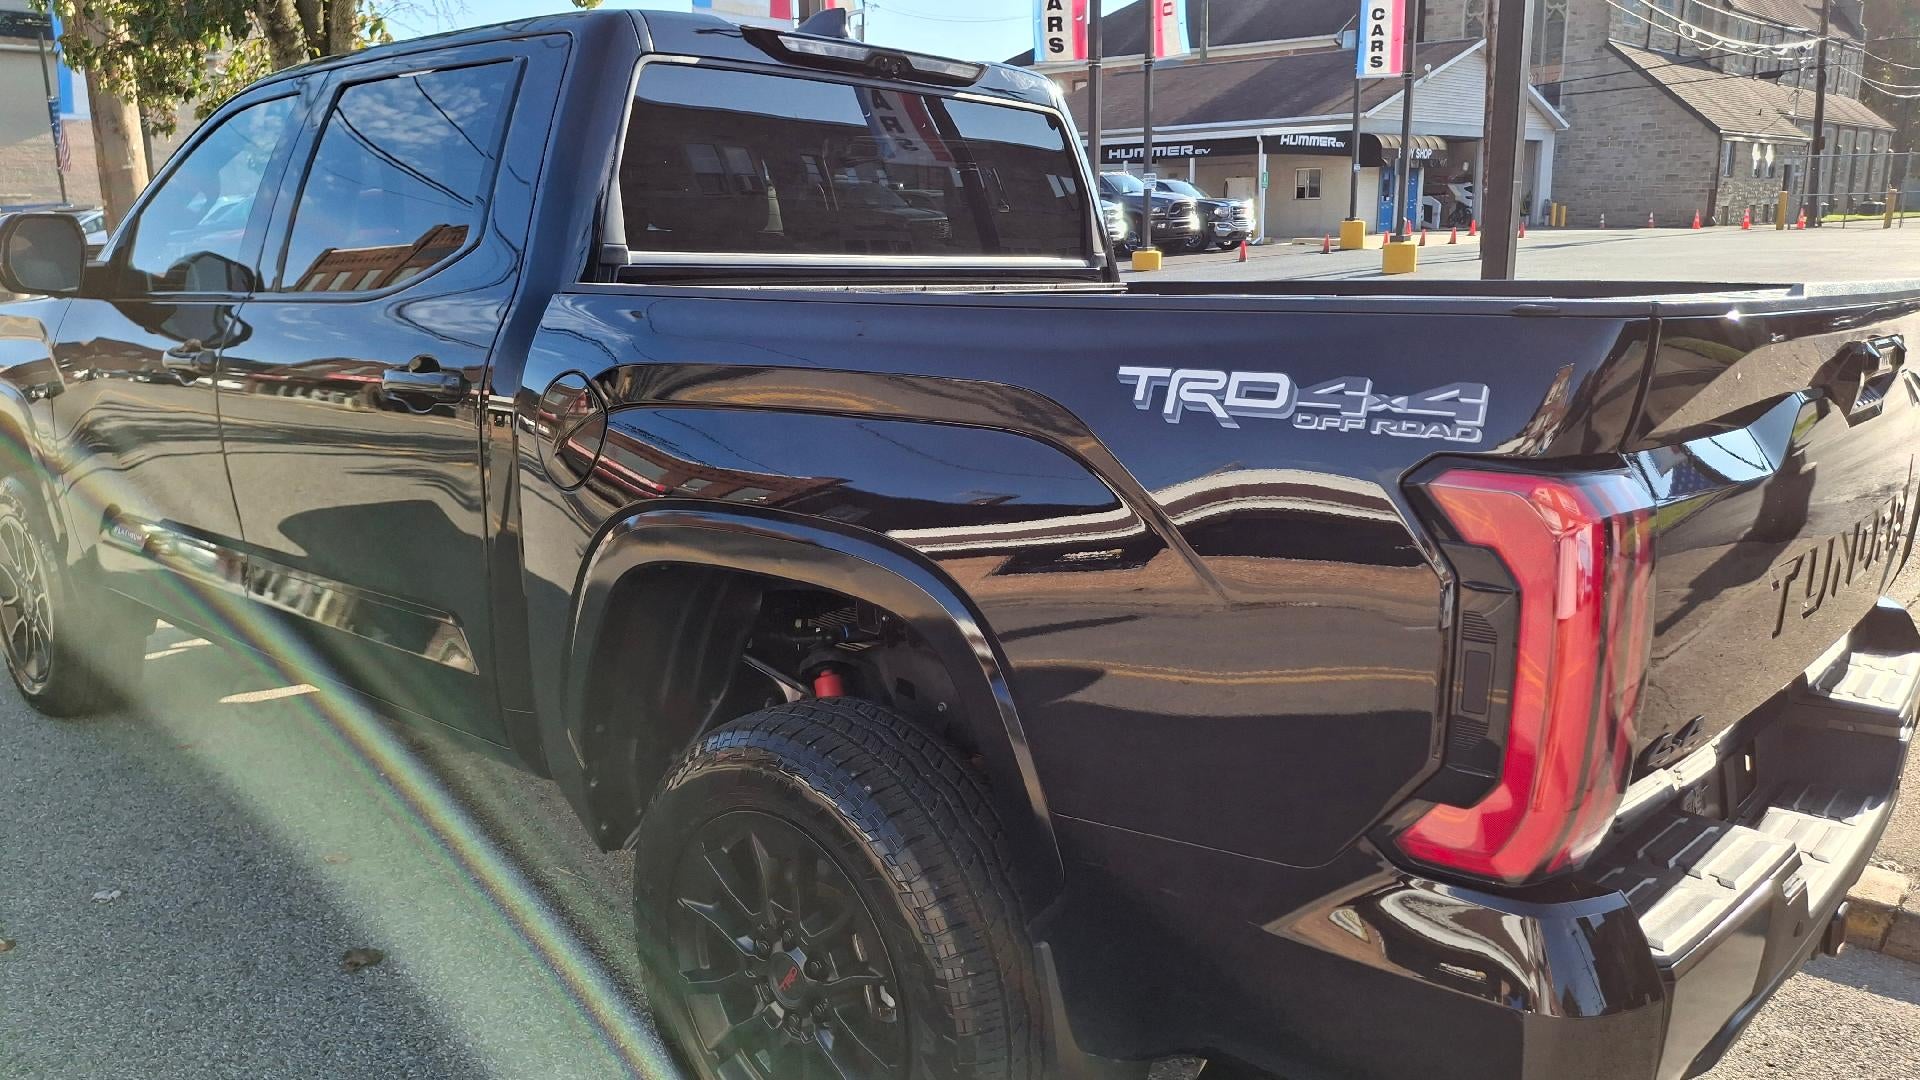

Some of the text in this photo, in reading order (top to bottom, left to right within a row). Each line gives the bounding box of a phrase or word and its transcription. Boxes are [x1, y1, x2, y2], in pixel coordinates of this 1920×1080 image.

[1370, 7, 1385, 68] CARS
[1280, 134, 1337, 147] HUMMER
[1416, 147, 1433, 159] SHOP
[1119, 366, 1299, 429] TRD
[1293, 412, 1484, 444] OFF ROAD
